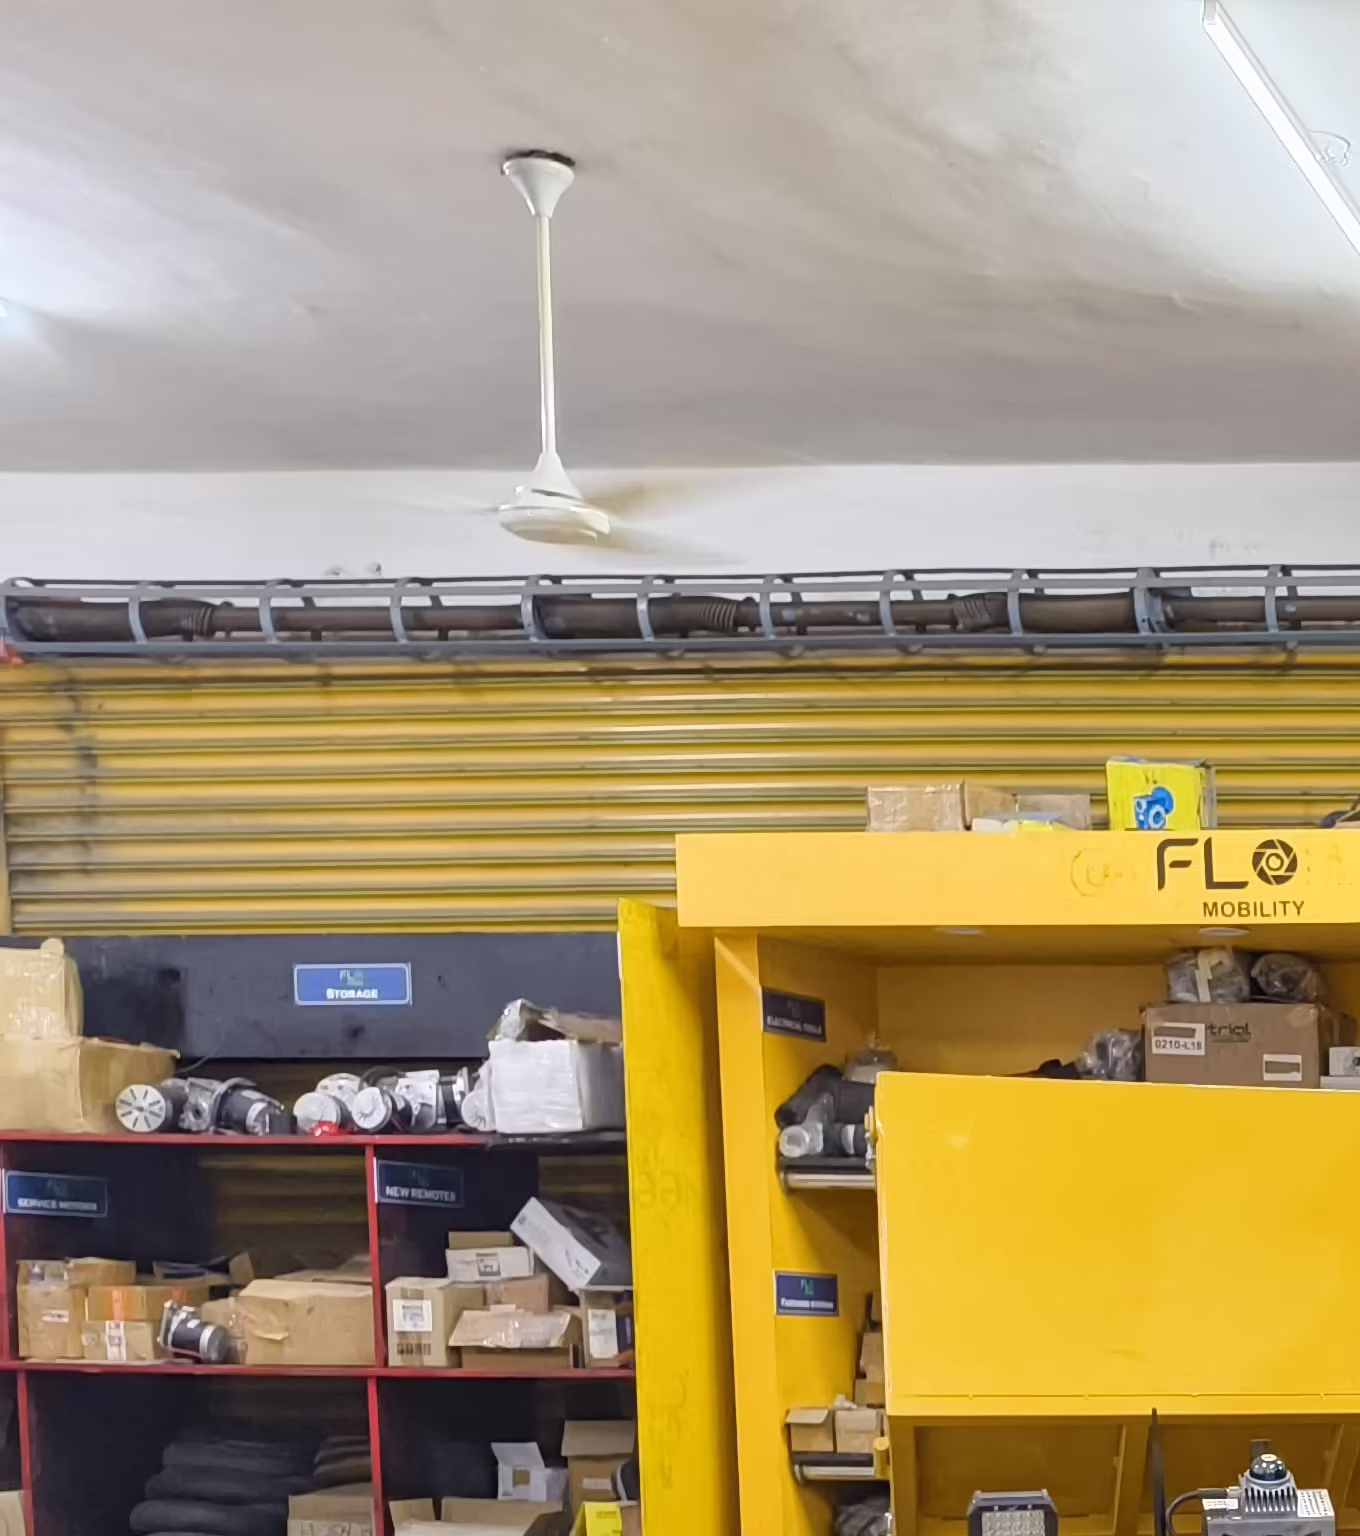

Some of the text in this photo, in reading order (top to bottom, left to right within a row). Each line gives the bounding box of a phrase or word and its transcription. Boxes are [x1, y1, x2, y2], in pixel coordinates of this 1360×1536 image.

[1157, 837, 1298, 891] FLO
[1203, 900, 1305, 918] MOBILITY
[326, 988, 379, 999] STORAGE
[1207, 1022, 1251, 1036] trial
